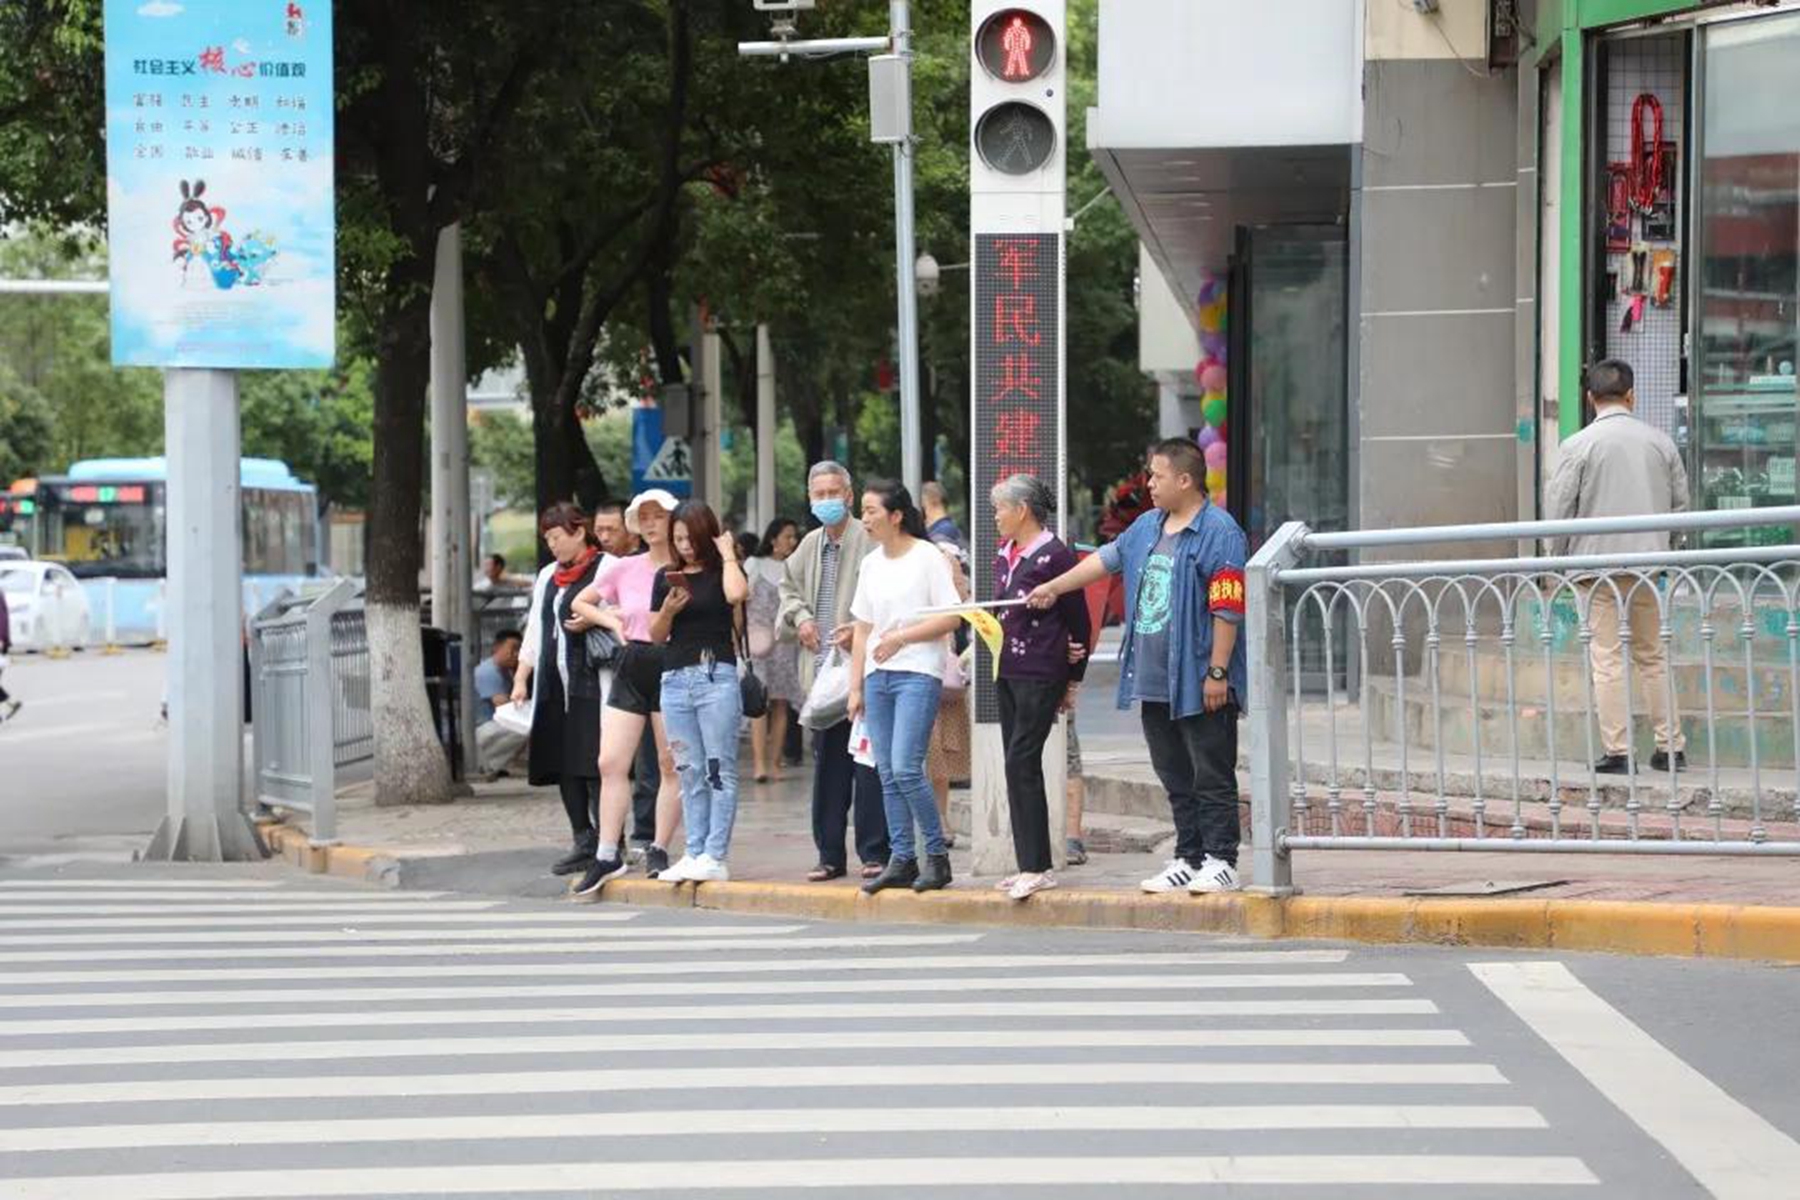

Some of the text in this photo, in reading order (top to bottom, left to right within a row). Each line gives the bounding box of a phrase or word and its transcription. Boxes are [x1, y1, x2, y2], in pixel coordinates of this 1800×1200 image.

[133, 46, 306, 78] 社会主义核心价值观
